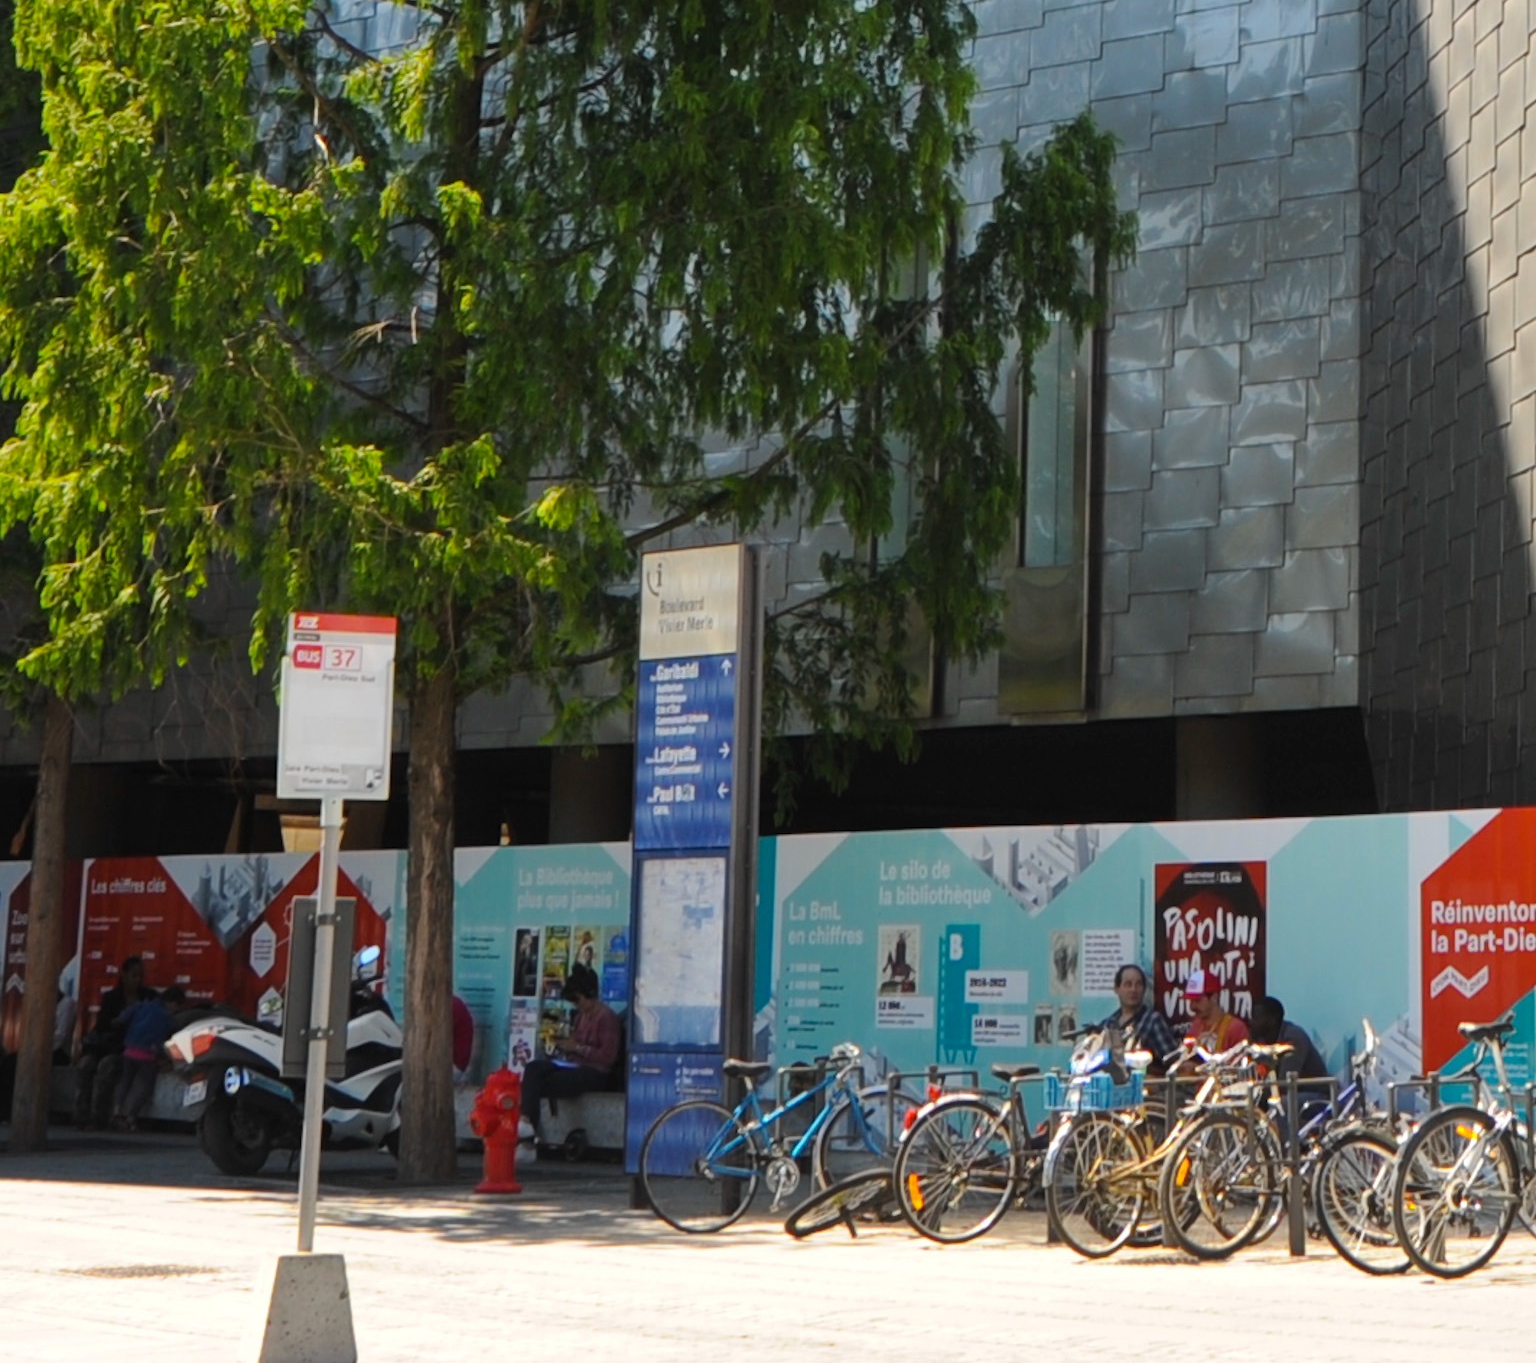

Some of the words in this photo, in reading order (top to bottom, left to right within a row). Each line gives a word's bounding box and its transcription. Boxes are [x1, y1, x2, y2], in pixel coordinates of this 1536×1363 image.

[660, 597, 704, 614] Boulevard
[659, 619, 684, 634] Vivier
[687, 616, 713, 631] Merle
[296, 649, 321, 663] BUS
[332, 650, 355, 667] 37
[656, 661, 698, 681] Garibaldi
[654, 746, 696, 766] Lafayette
[654, 785, 674, 802] Paul
[519, 870, 534, 886] La
[537, 867, 613, 888] Bibliothèque
[880, 862, 897, 880] Le
[901, 859, 928, 879] silo
[932, 861, 951, 879] de
[91, 878, 107, 894] Les
[110, 877, 145, 893] chiffres
[147, 875, 167, 892] clés
[517, 893, 543, 911] plus
[545, 893, 568, 911] que
[570, 891, 612, 912] jamais
[614, 891, 620, 908] !
[879, 886, 892, 905] la
[896, 883, 992, 908] bibliothèque
[11, 910, 29, 926] Zoo
[789, 902, 805, 920] La
[810, 901, 841, 920] BmL
[788, 929, 805, 945] en
[808, 925, 863, 945] chiffres
[1163, 906, 1259, 952] PASOLINI
[950, 933, 963, 961] B
[1431, 929, 1449, 953] la
[1164, 950, 1201, 983] UNA
